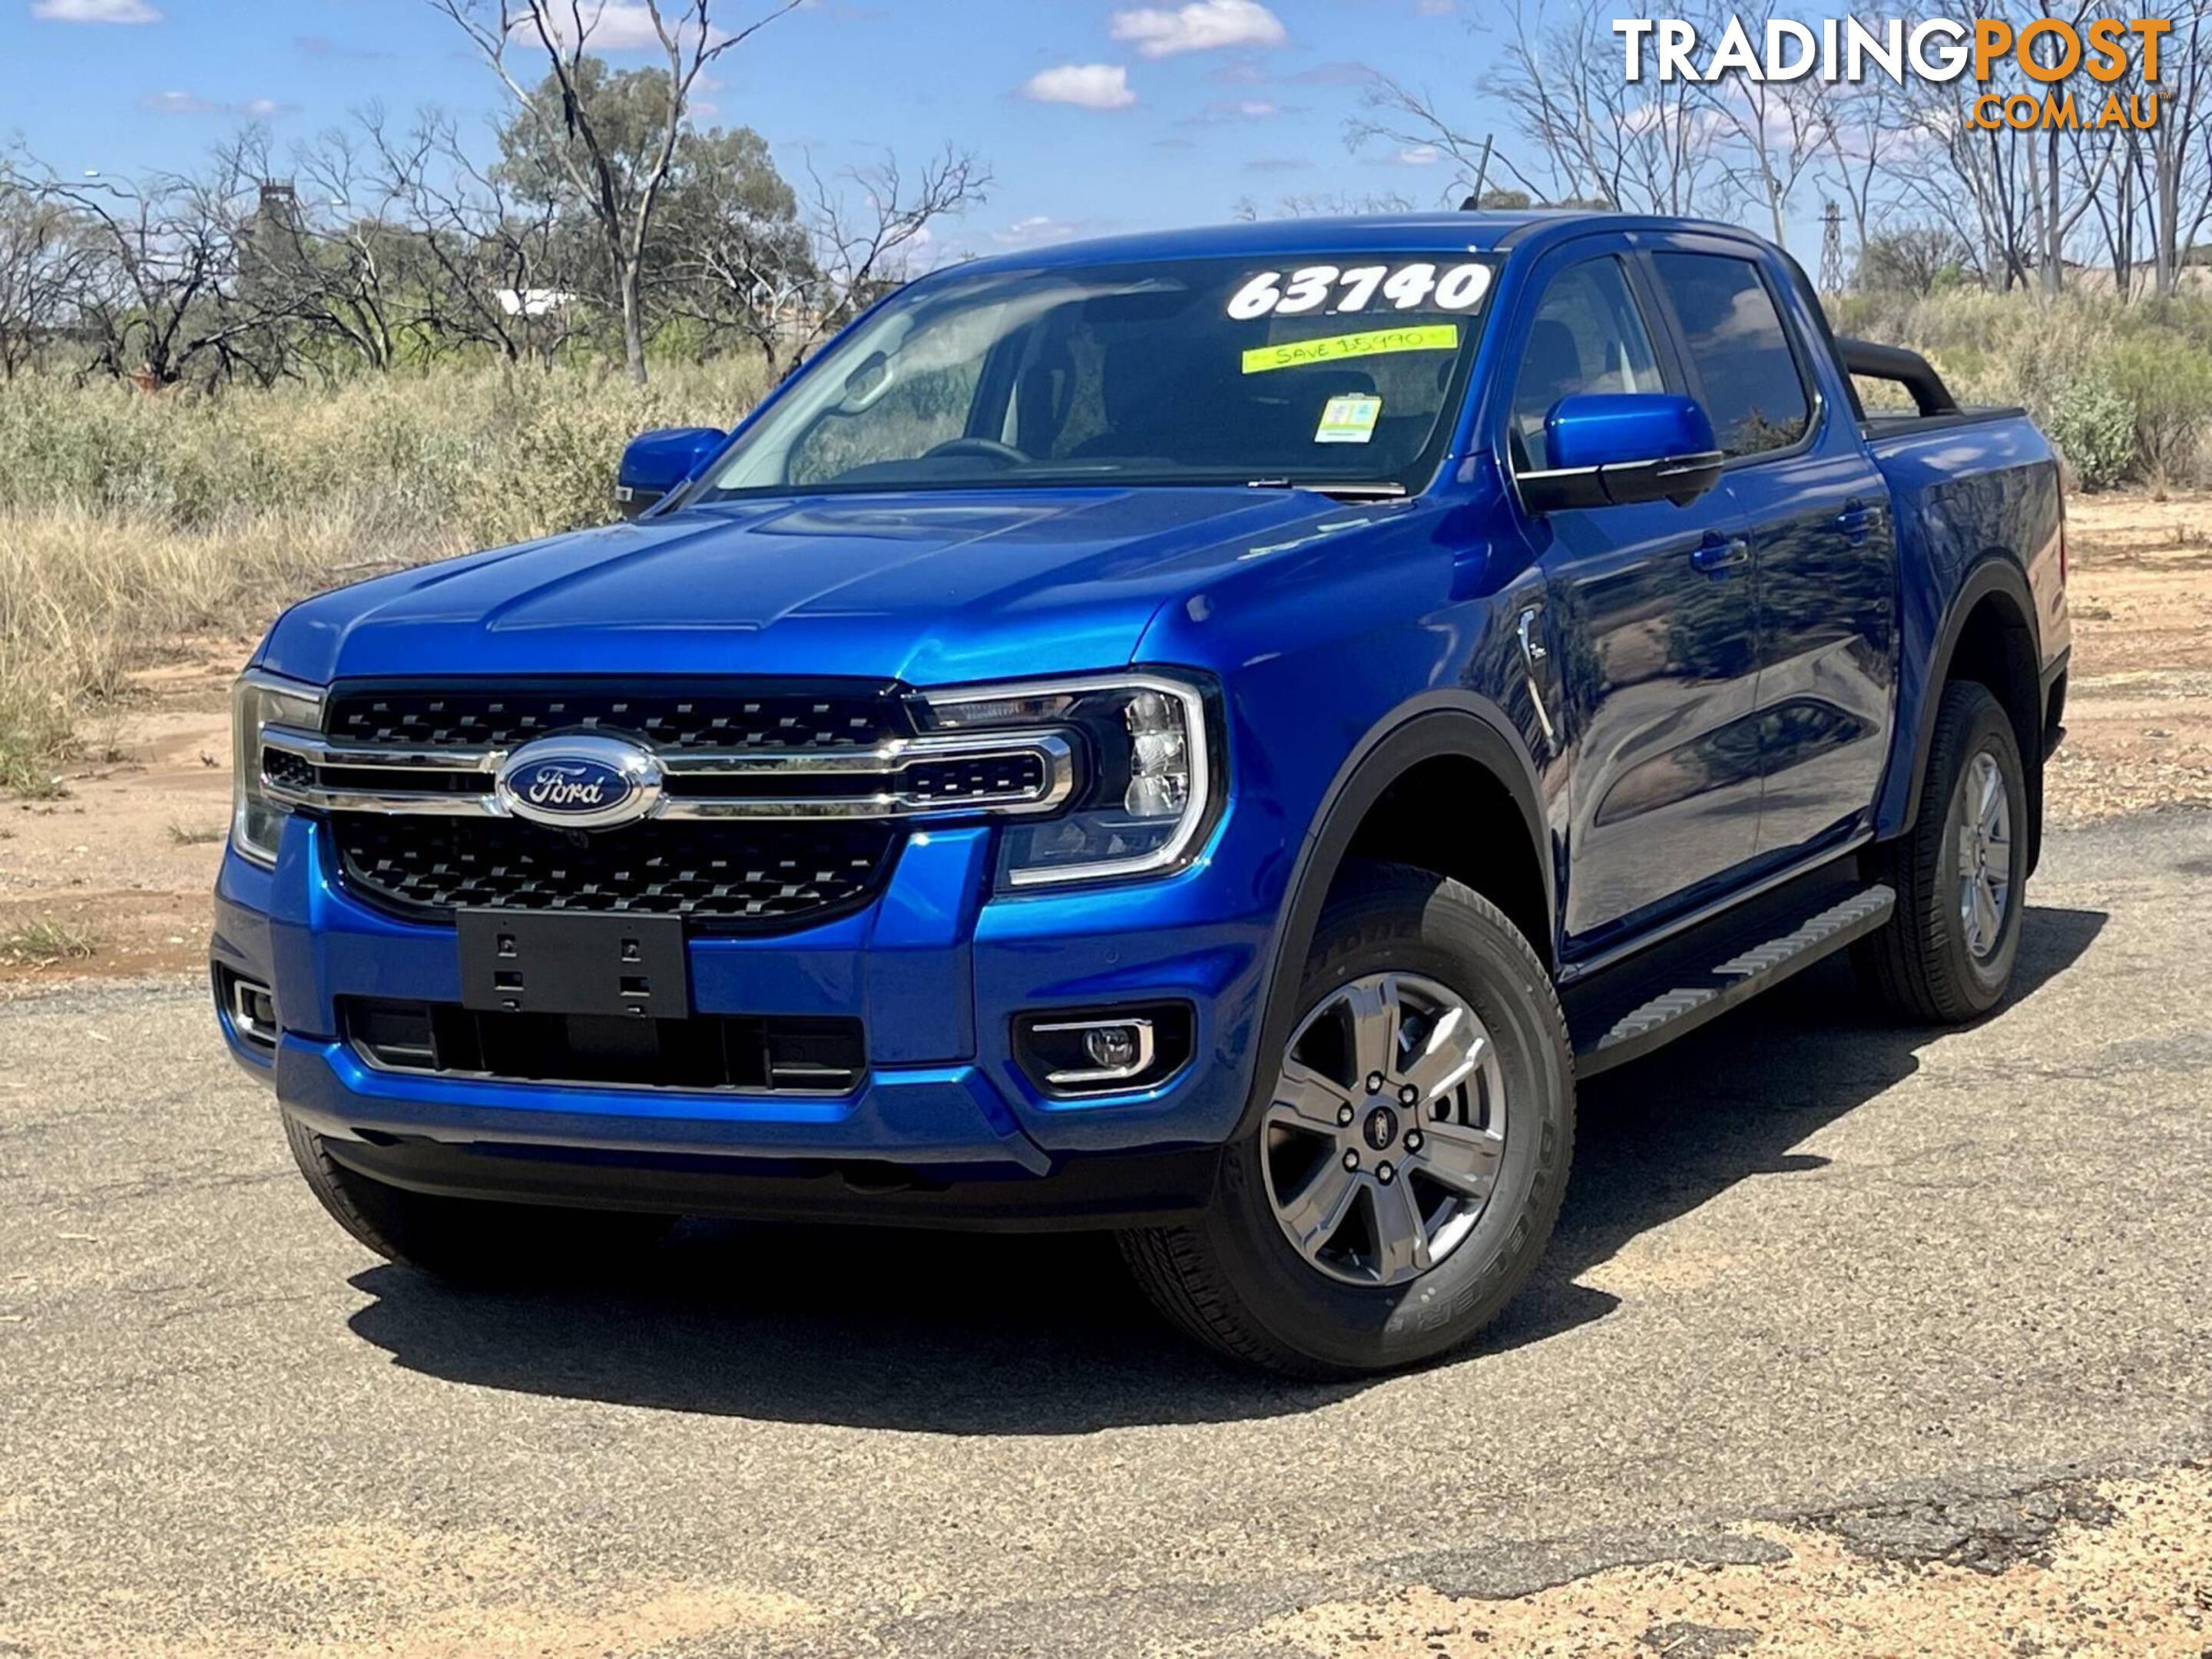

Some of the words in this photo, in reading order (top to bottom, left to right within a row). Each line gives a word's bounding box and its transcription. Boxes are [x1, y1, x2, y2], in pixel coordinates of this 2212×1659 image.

[1227, 263, 1492, 320] 63740
[1275, 344, 1329, 364] SAVE
[528, 767, 606, 804] Ford
